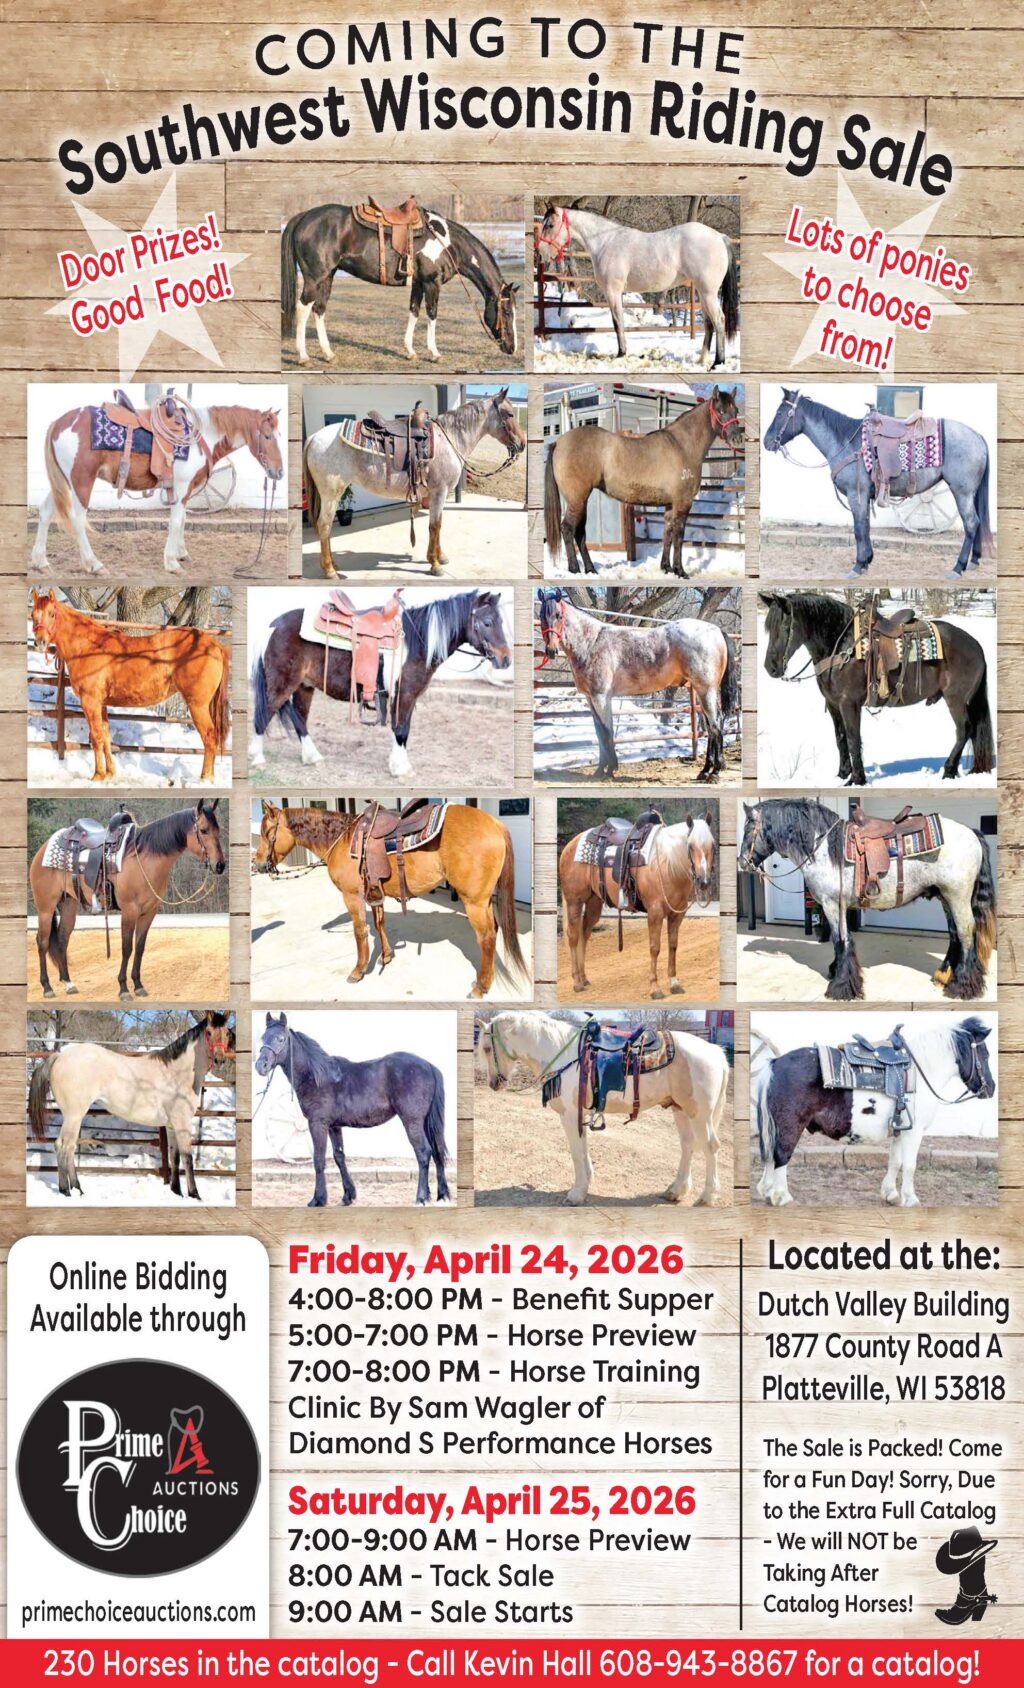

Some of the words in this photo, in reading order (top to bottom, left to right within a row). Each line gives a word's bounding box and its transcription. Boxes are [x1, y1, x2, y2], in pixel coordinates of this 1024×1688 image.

[255, 16, 504, 76] COMING
[530, 17, 607, 60] TO
[632, 21, 745, 75] THE
[58, 86, 351, 196] Southwest
[360, 71, 632, 134] Wisconsin
[650, 79, 824, 178] Riding
[836, 113, 953, 196] Sale
[60, 247, 125, 288] Door
[130, 215, 220, 269] Prizes!
[787, 208, 845, 255] Lots
[849, 230, 883, 264] of
[878, 244, 970, 291] ponies
[71, 295, 144, 335] Good
[155, 262, 232, 313] Food!
[803, 266, 832, 302] to
[837, 276, 932, 331] choose
[820, 318, 894, 370] from!
[289, 1243, 416, 1283] Friday,
[423, 1243, 511, 1283] April
[520, 1244, 579, 1281] 24,
[587, 1244, 684, 1275] 2026
[769, 1238, 891, 1271] Located
[899, 1241, 934, 1271] at
[941, 1238, 1000, 1271] the:
[49, 1260, 127, 1291] Online
[136, 1260, 227, 1299] Bidding
[288, 1287, 433, 1311] 4:00-8:00
[442, 1287, 483, 1310] PM
[513, 1286, 611, 1311] Benefit
[618, 1287, 714, 1317] Supper
[758, 1290, 829, 1317] Dutch
[835, 1290, 907, 1324] Valley
[914, 1290, 1009, 1325] Building
[29, 1302, 143, 1332] Available
[149, 1302, 246, 1341] through
[288, 1323, 429, 1347] 5:00-7:00
[437, 1323, 478, 1346] PM
[508, 1323, 584, 1347] Horse
[592, 1322, 697, 1347] Preview
[765, 1332, 819, 1359] 1877
[825, 1332, 911, 1366] County
[917, 1332, 980, 1359] Road
[985, 1333, 1003, 1358] A
[287, 1359, 431, 1383] 7:00-8:00
[439, 1359, 480, 1382] PM
[510, 1359, 586, 1383] Horse
[592, 1358, 700, 1390] Training
[763, 1374, 890, 1405] Platteville,
[896, 1375, 926, 1401] WI
[934, 1374, 1006, 1401] 53818
[288, 1395, 361, 1419] Clinic
[370, 1396, 402, 1425] By
[408, 1395, 468, 1419] Sam
[474, 1395, 572, 1426] Wagler
[577, 1395, 607, 1419] of
[58, 1401, 163, 1486] Prime
[289, 1430, 411, 1455] Diamond
[418, 1431, 434, 1455] S
[443, 1430, 616, 1455] Performance
[624, 1431, 713, 1455] Horses
[763, 1437, 798, 1457] The
[802, 1437, 844, 1457] Sale
[849, 1438, 863, 1457] is
[868, 1437, 943, 1457] Packed!
[948, 1438, 1003, 1457] Come
[153, 1482, 238, 1495] AUCTIONS
[763, 1469, 790, 1489] for
[794, 1474, 806, 1489] a
[812, 1470, 846, 1489] Fun
[851, 1470, 894, 1494] Day!
[899, 1469, 953, 1494] Sorry,
[958, 1470, 995, 1489] Due
[77, 1456, 186, 1550] Choice
[288, 1485, 454, 1524] Saturday,
[461, 1484, 541, 1524] April
[549, 1485, 600, 1521] 25,
[608, 1485, 696, 1516] 2026
[763, 1502, 783, 1520] to
[788, 1500, 820, 1520] the
[826, 1501, 876, 1520] Extra
[882, 1500, 915, 1520] Full
[920, 1500, 996, 1525] Catalog
[287, 1528, 428, 1552] 7:00-9:00
[433, 1528, 477, 1551] AM
[506, 1528, 580, 1552] Horse
[589, 1527, 692, 1552] Preview
[776, 1532, 806, 1551] We
[811, 1531, 842, 1550] will
[848, 1531, 889, 1551] NOT
[893, 1531, 918, 1551] be
[288, 1563, 353, 1587] 8:00
[358, 1564, 402, 1587] AM
[429, 1563, 491, 1587] Tack
[498, 1563, 554, 1587] Sale
[763, 1562, 826, 1588] Taking
[830, 1562, 879, 1582] After
[22, 1599, 256, 1629] primechoiceauctions.com
[288, 1599, 352, 1623] 9:00
[358, 1600, 402, 1623] AM
[430, 1599, 487, 1623] Sale
[494, 1599, 574, 1623] Starts
[763, 1593, 839, 1619] Catalog
[845, 1594, 913, 1613] Horses!
[44, 1649, 95, 1677] 230
[104, 1650, 189, 1677] Horses
[197, 1649, 219, 1676] in
[226, 1649, 271, 1676] the
[278, 1649, 379, 1685] catalog
[407, 1649, 455, 1676] Call
[464, 1649, 533, 1676] Kevin
[543, 1649, 591, 1676] Hall
[600, 1649, 798, 1677] 608-943-8867
[805, 1648, 841, 1676] for
[847, 1656, 863, 1676] a
[871, 1649, 980, 1685] catalog!
